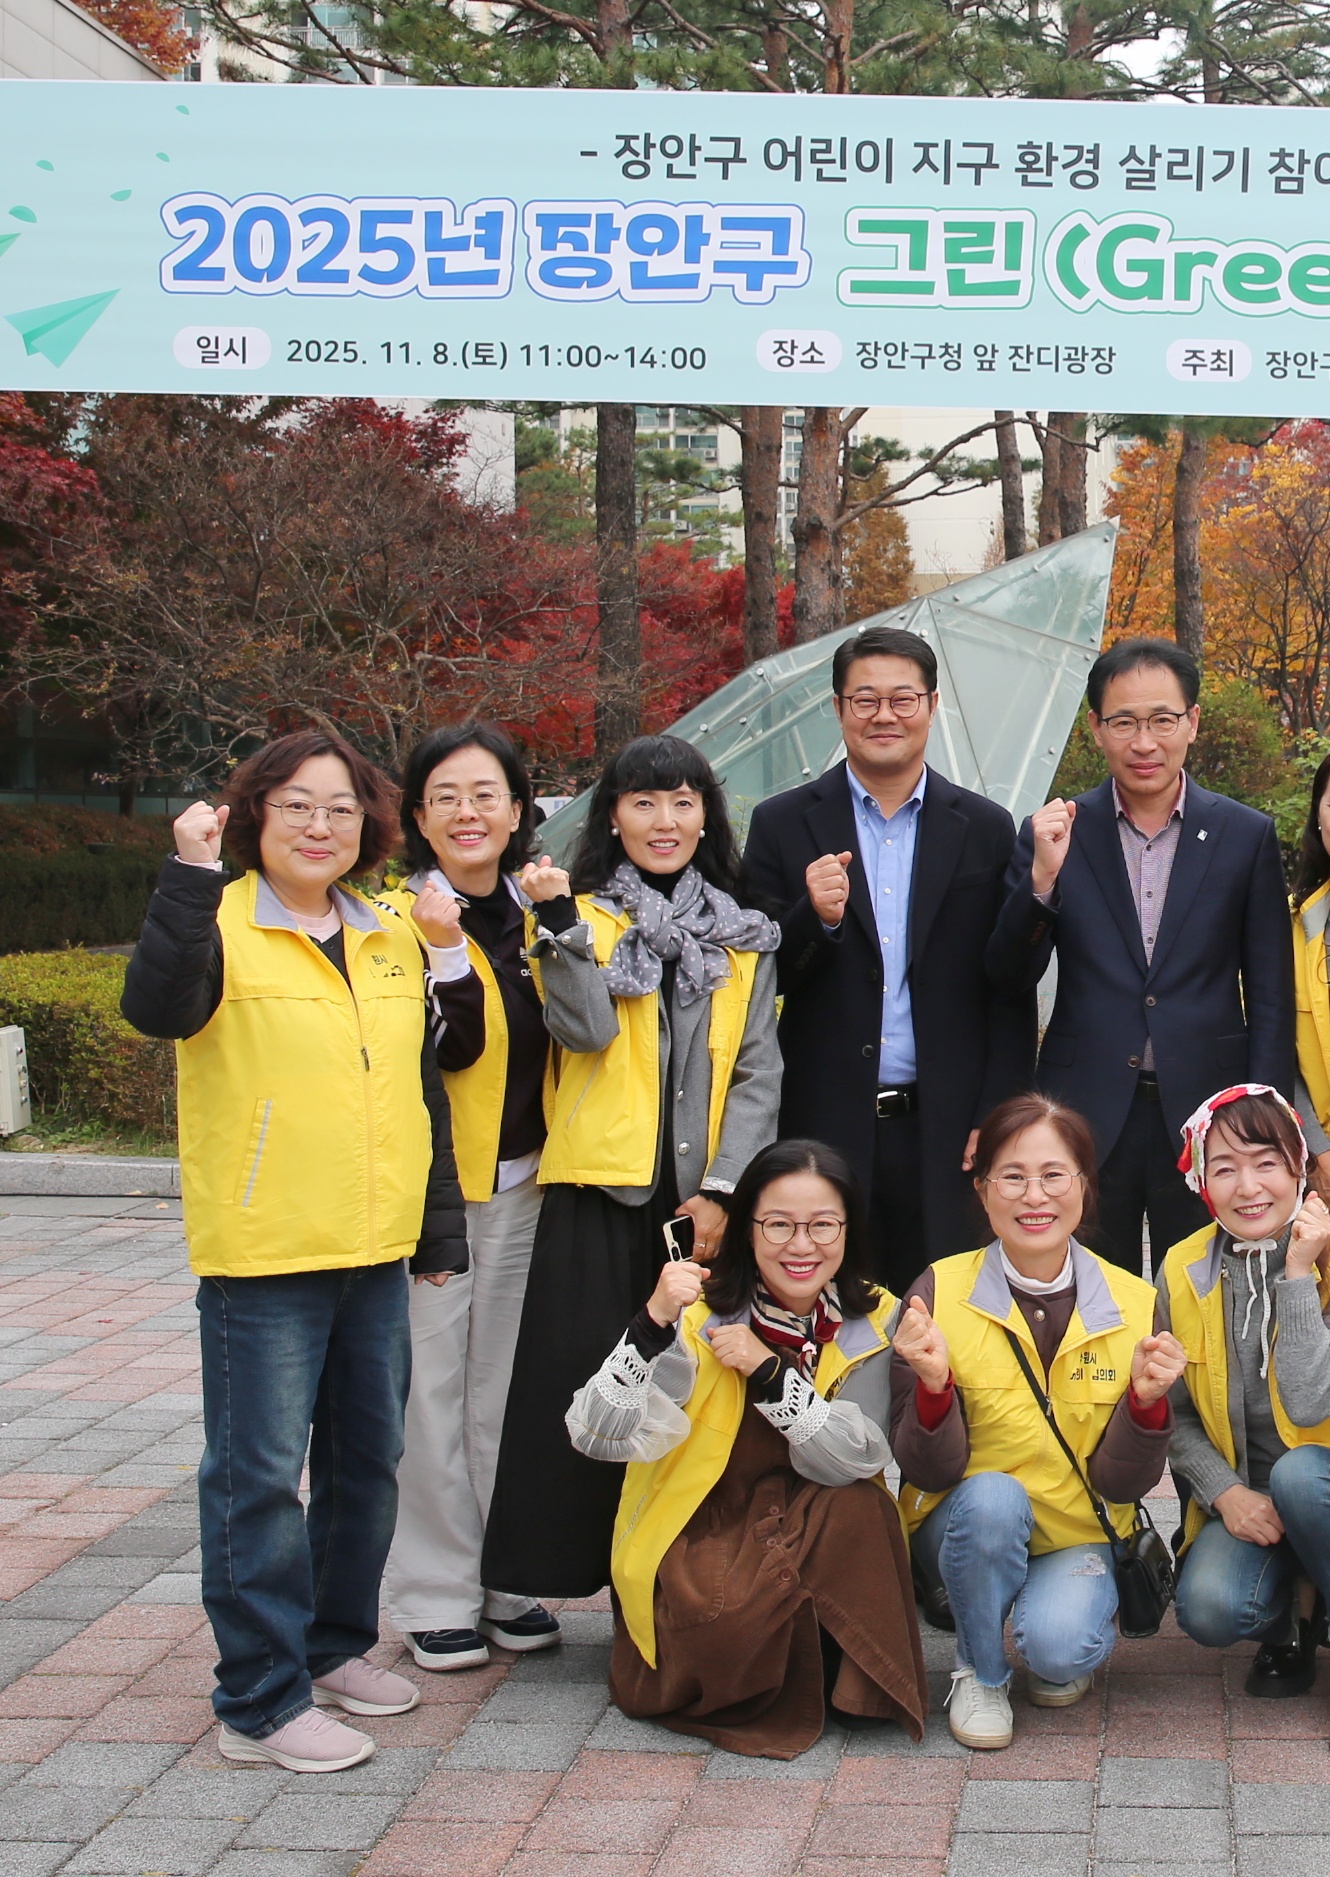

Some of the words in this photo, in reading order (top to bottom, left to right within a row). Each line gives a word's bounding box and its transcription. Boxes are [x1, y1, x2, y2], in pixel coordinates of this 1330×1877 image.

[613, 132, 747, 181] 장안구
[763, 135, 893, 184] 어린이
[912, 139, 1000, 186] 지구
[1014, 140, 1101, 190] 환경
[1118, 144, 1250, 193] 살리기
[169, 202, 508, 290] 2025년
[533, 209, 801, 293] 장안구
[848, 216, 1027, 298] 그린
[196, 335, 248, 364] 일시
[287, 339, 367, 365] 2025.
[380, 341, 421, 366] 11.
[433, 341, 508, 370] 8.(토)
[520, 344, 706, 370] 11:00~14:00
[772, 339, 826, 368] 장소
[856, 341, 962, 373] 장안구청
[973, 343, 999, 373] 앞
[1008, 344, 1117, 375] 잔디광장
[1182, 349, 1234, 378] 주최
